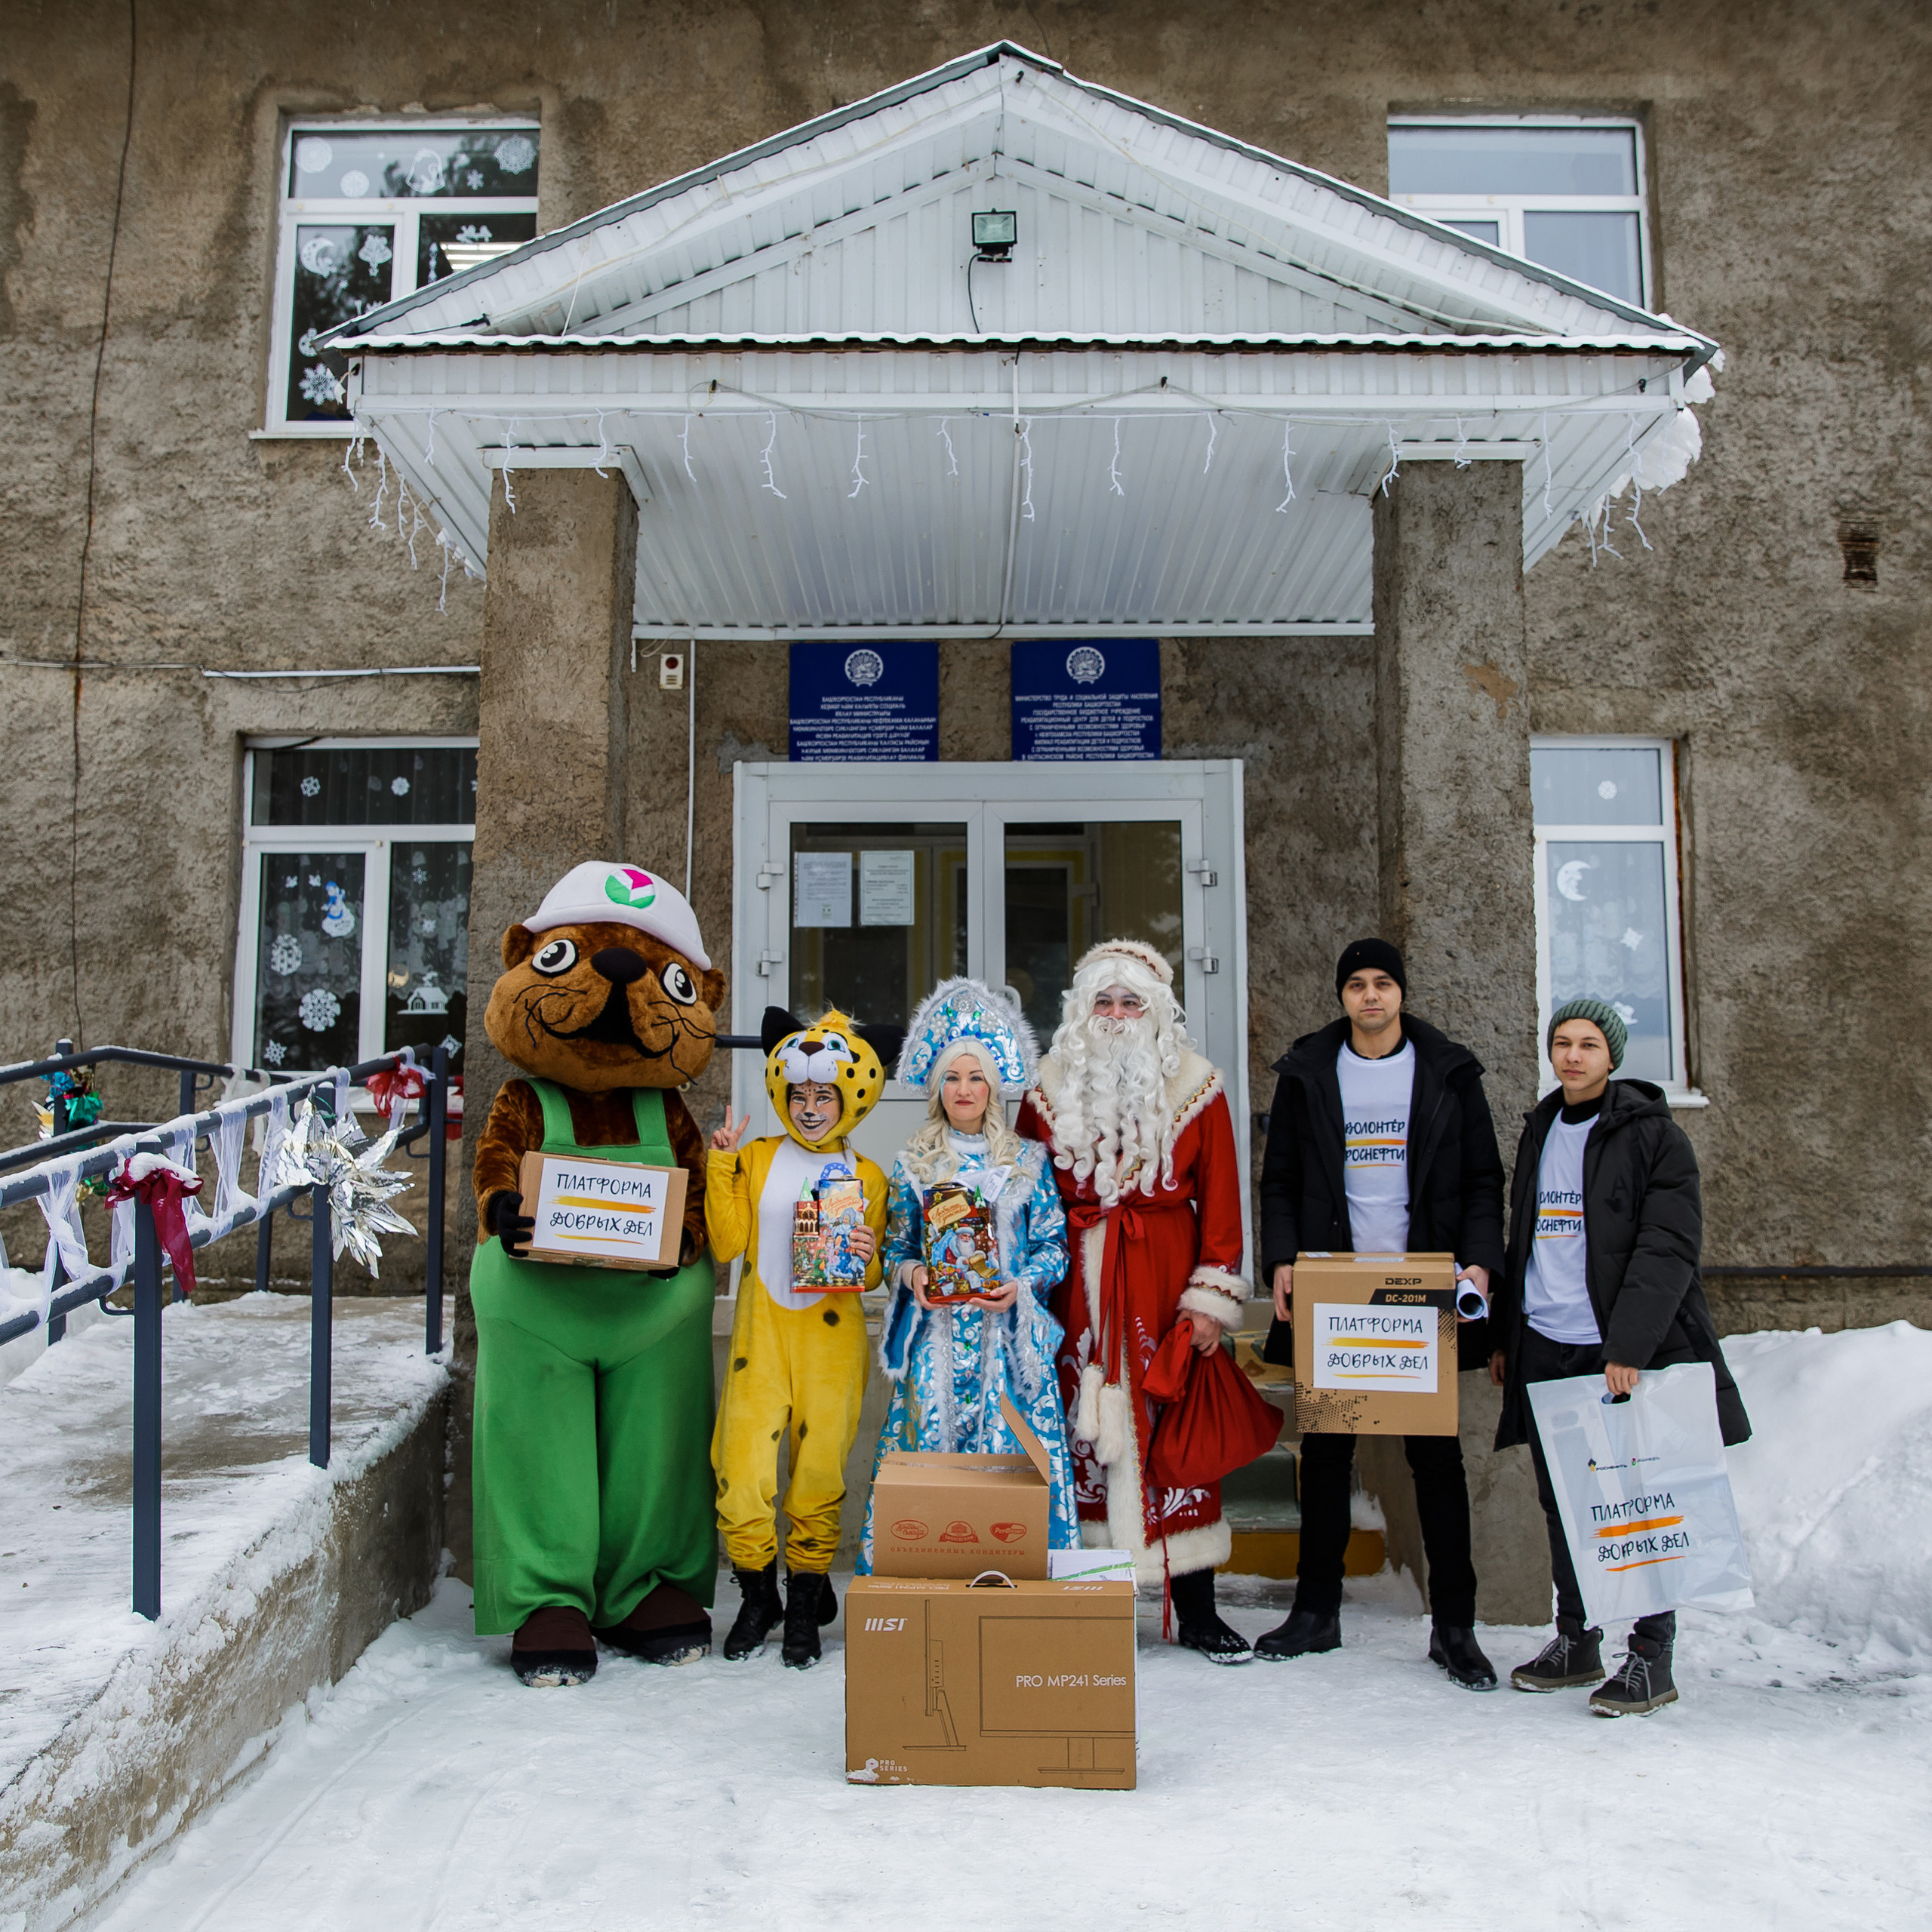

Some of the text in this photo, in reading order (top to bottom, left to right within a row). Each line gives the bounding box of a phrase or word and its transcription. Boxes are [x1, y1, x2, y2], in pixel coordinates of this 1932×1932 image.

[1345, 1148, 1405, 1161] РОСНЕФТИ
[557, 1174, 651, 1198] ПЛАТФОРМА
[550, 1212, 653, 1236] ДОБРЫХ ДЕЛ
[1535, 1219, 1582, 1232] ОСНЕФТИ
[1386, 1294, 1426, 1303] DC-201M
[1328, 1317, 1423, 1334] ПЛАТФОРМА
[1327, 1353, 1429, 1370] ДОБРЫХ ДЕЛ
[1661, 1531, 1690, 1552] ДЕЛ
[1016, 1674, 1127, 1687] PRO MP241 Series
